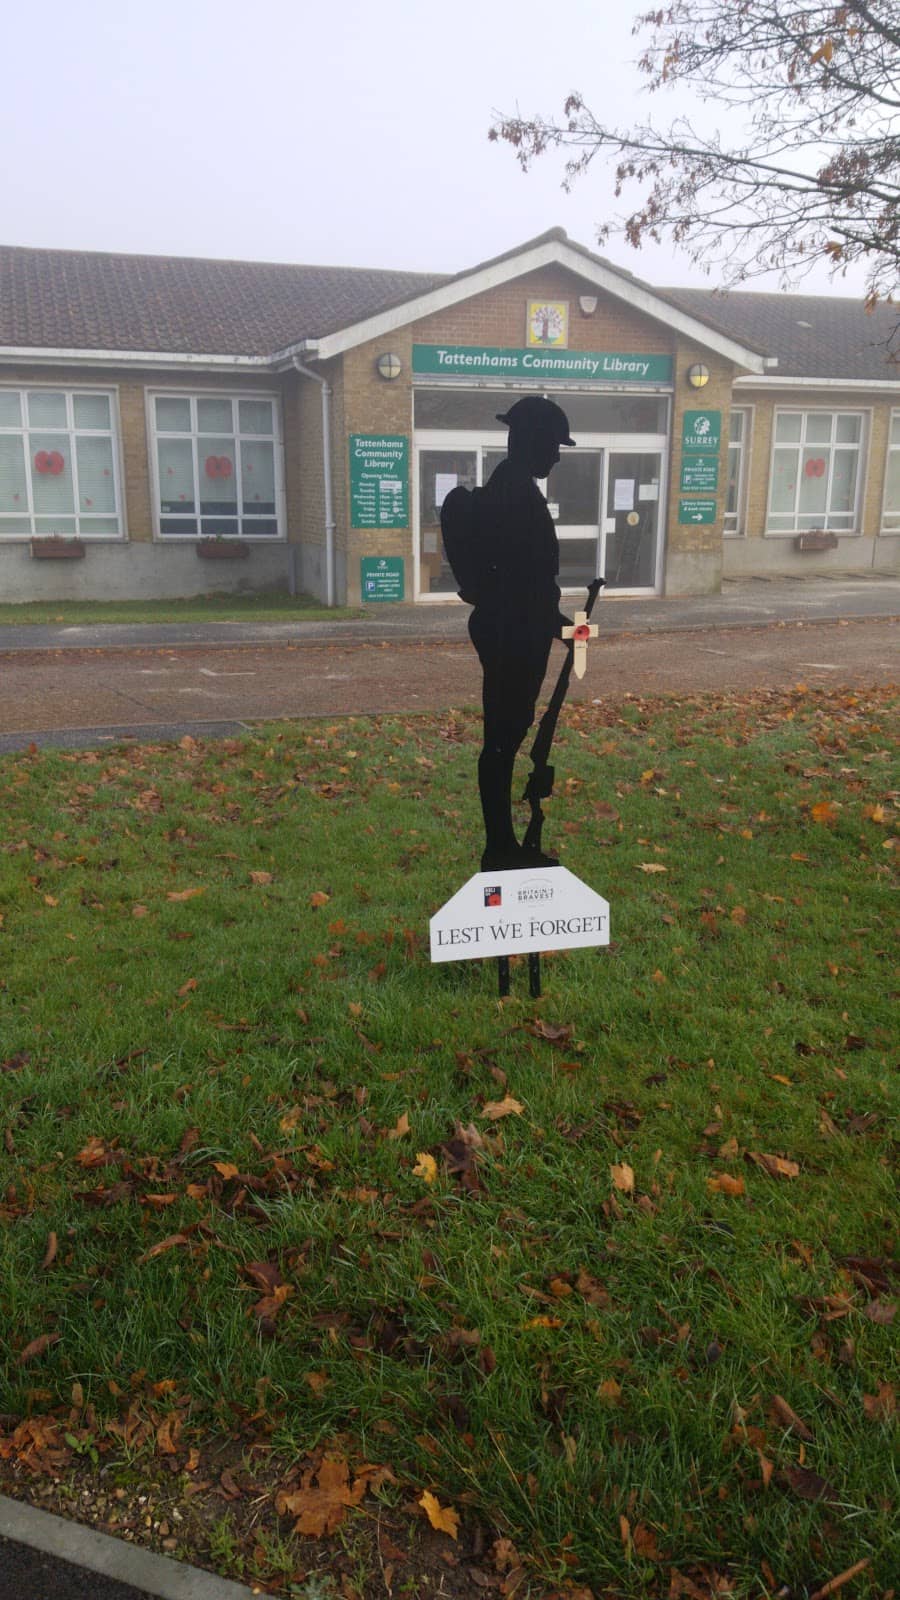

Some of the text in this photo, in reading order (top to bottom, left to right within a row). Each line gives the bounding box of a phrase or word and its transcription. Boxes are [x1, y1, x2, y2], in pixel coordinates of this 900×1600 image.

[437, 350, 650, 375] Tattenhams Community Library
[355, 438, 404, 448] Tattenhams
[685, 436, 718, 447] SURREY
[355, 448, 403, 460] Community
[364, 459, 395, 470] Library
[361, 472, 382, 480] Opening
[518, 893, 554, 901] BRAVEST
[436, 915, 607, 946] LEST WE FORGET
